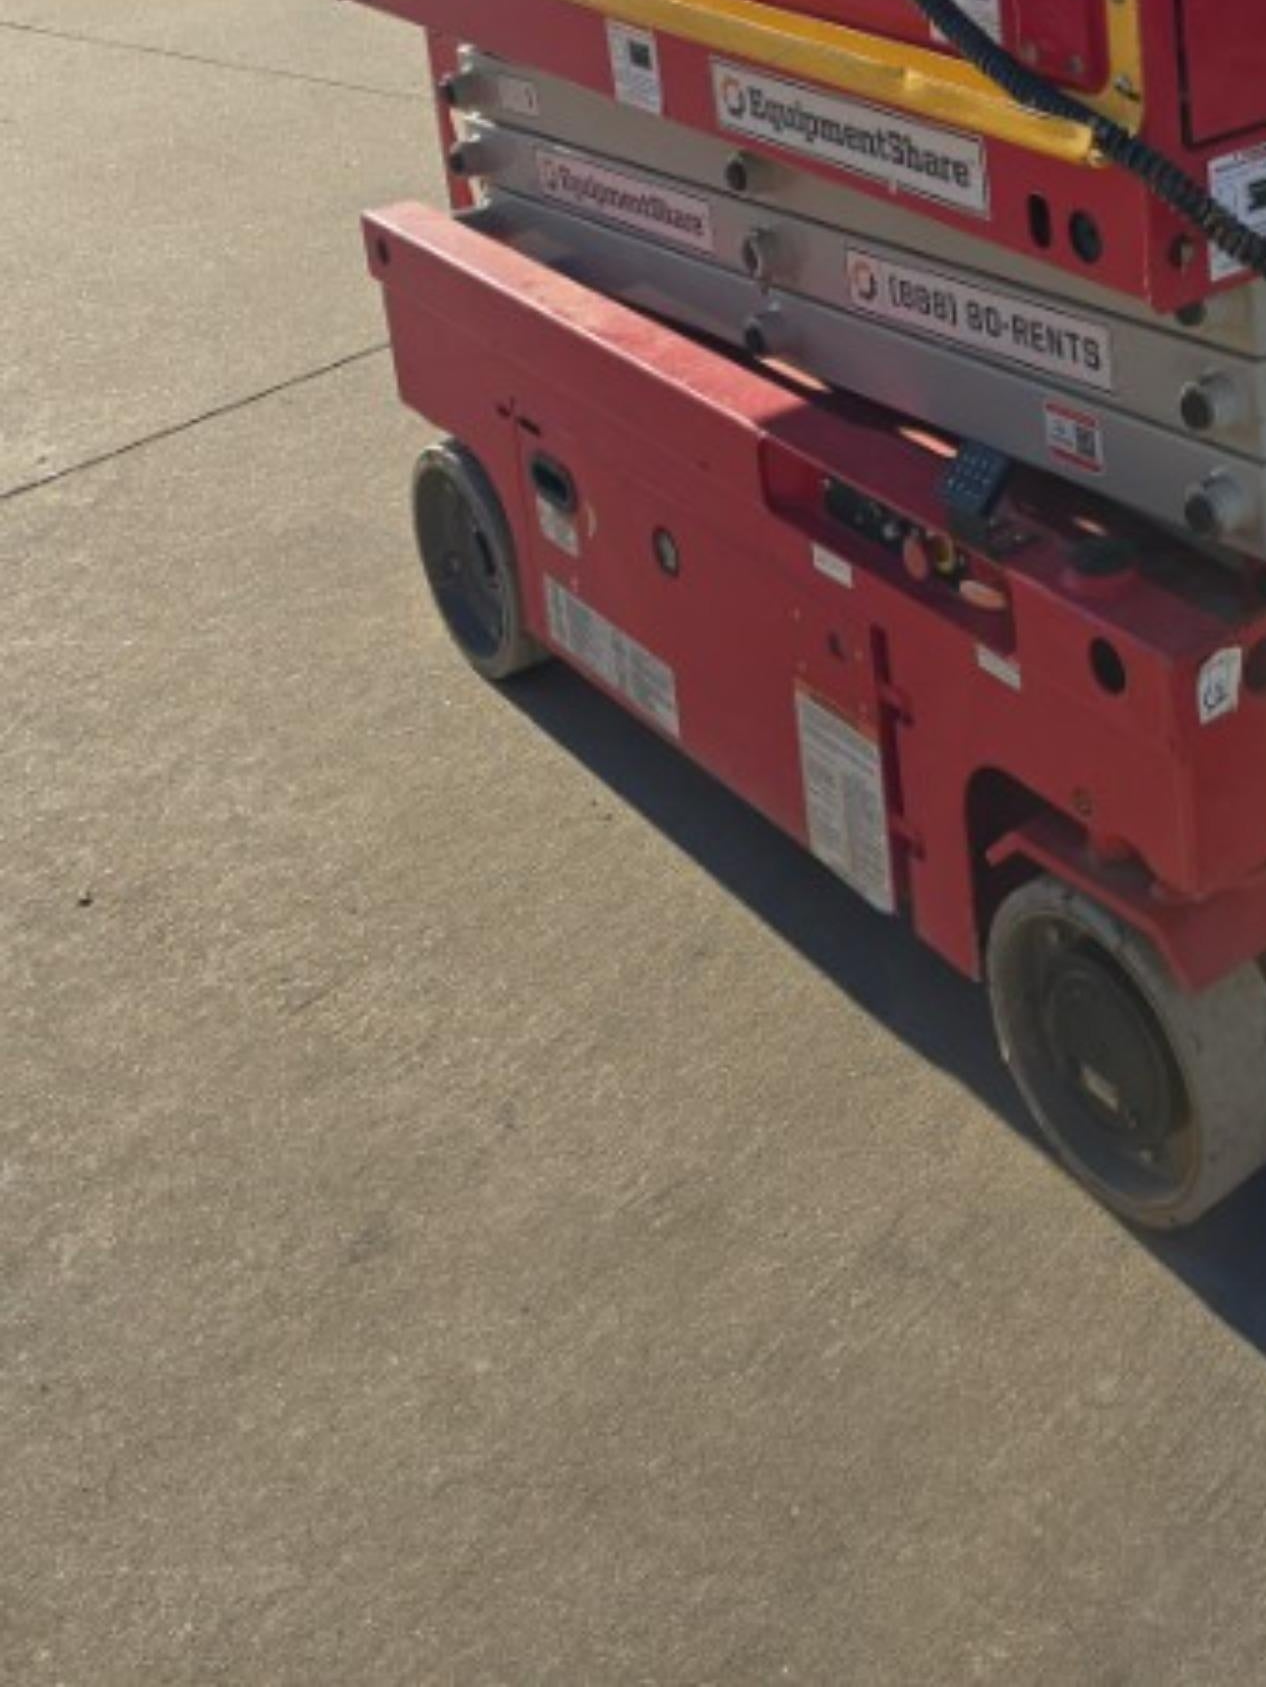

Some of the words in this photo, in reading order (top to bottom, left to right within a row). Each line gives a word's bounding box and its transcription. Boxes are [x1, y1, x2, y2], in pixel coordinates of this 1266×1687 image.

[748, 85, 972, 188] EquipmentShare
[888, 273, 959, 327] (888)
[965, 299, 1102, 372] 80-RENTS
